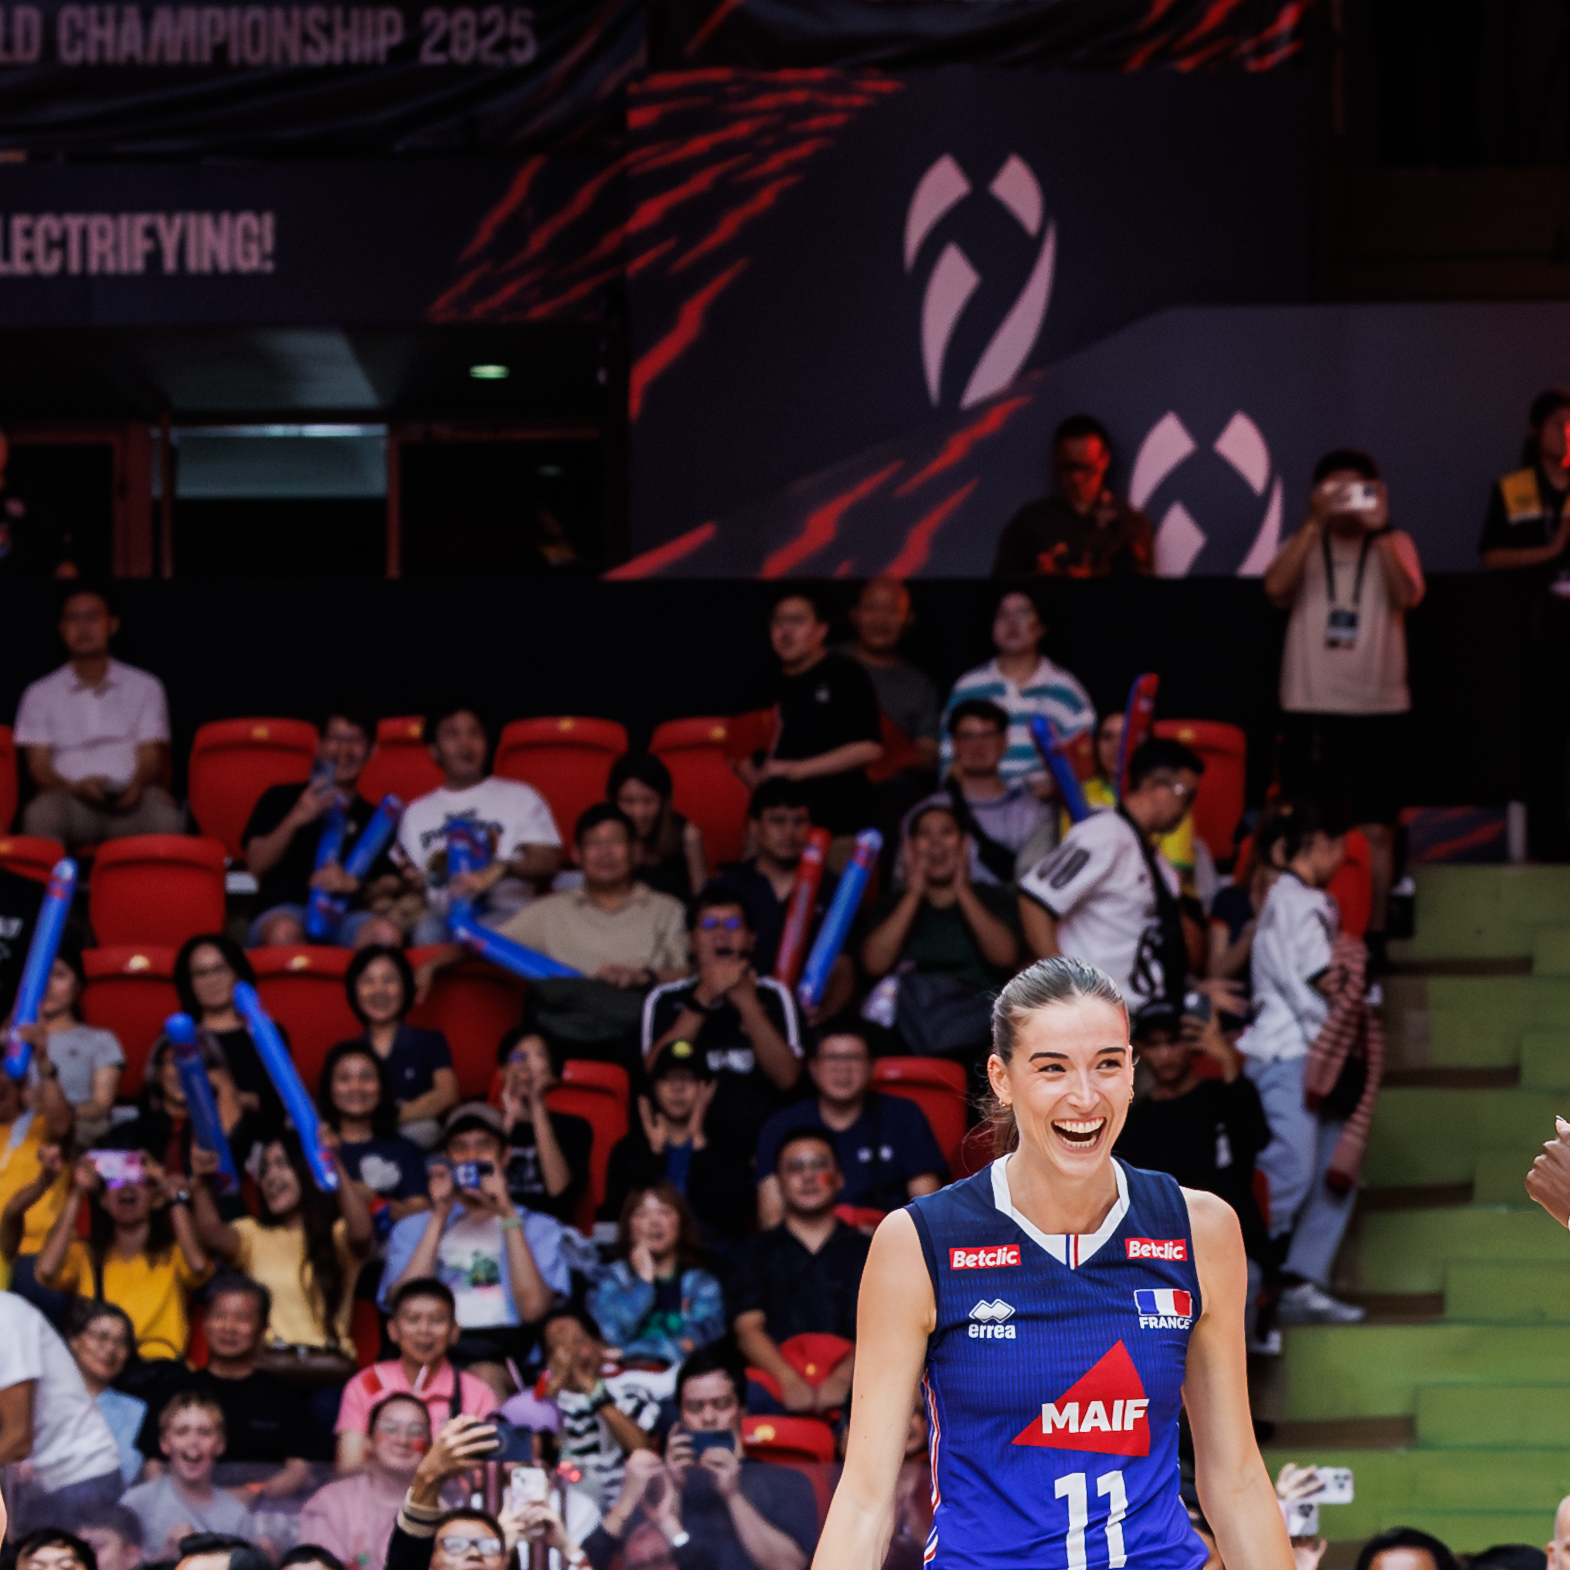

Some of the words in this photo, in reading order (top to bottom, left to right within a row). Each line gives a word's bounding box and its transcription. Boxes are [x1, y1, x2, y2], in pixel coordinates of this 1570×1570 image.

[57, 8, 406, 66] CHAMPIONSHIP
[419, 8, 538, 66] 2025
[952, 1247, 1019, 1268] Betclic
[1128, 1241, 1185, 1260] Betclic
[968, 1324, 1016, 1340] errea
[1139, 1316, 1190, 1330] FRANCE
[1041, 1398, 1150, 1434] MAIF
